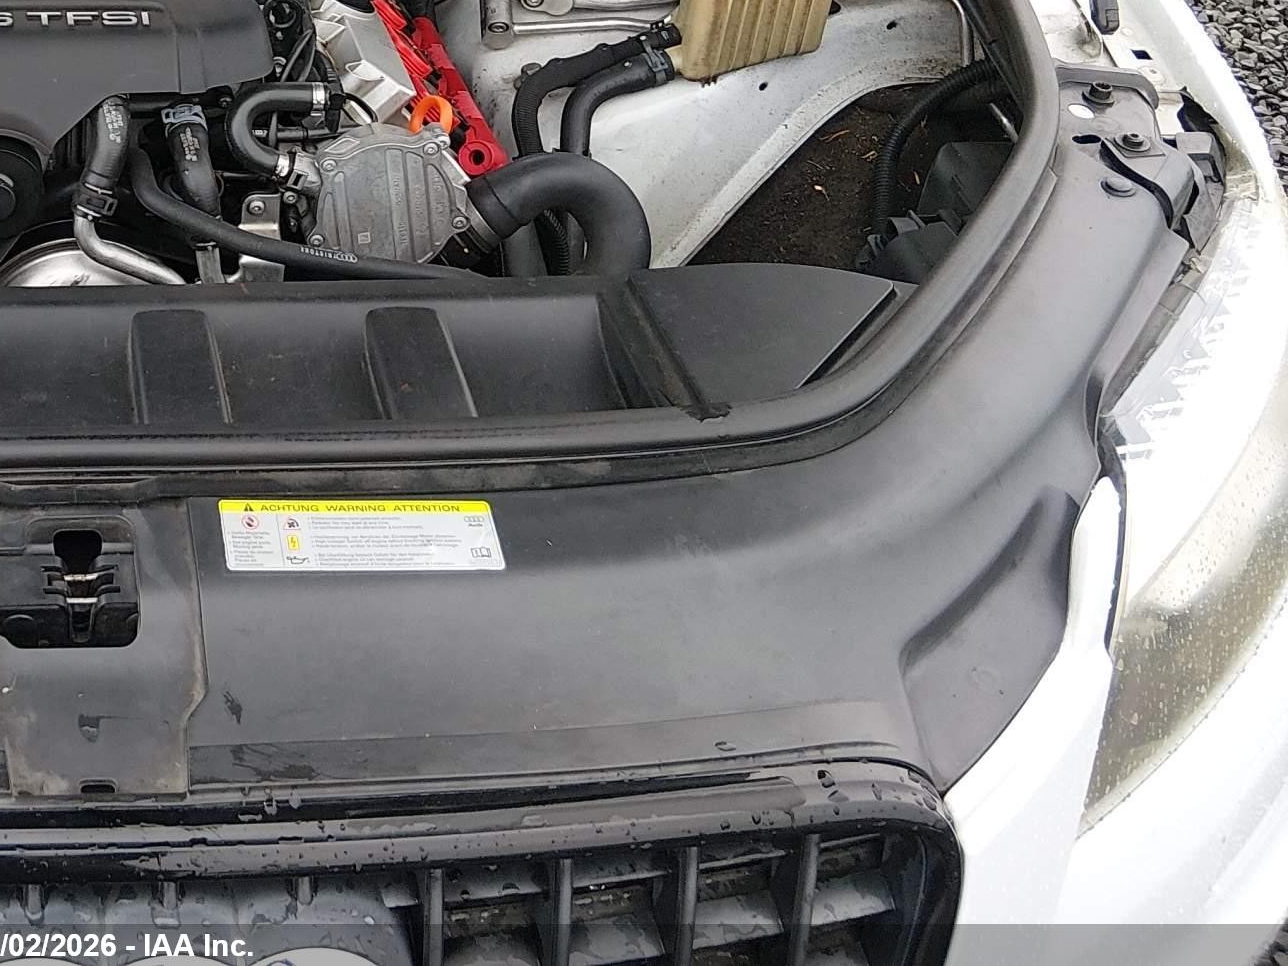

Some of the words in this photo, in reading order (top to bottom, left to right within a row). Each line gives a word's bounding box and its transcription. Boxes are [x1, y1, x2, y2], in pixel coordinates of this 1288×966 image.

[25, 10, 151, 26] TFSI
[260, 504, 320, 512] ACHTUNG
[326, 504, 386, 513] WARNING
[393, 504, 460, 513] ATTENTION
